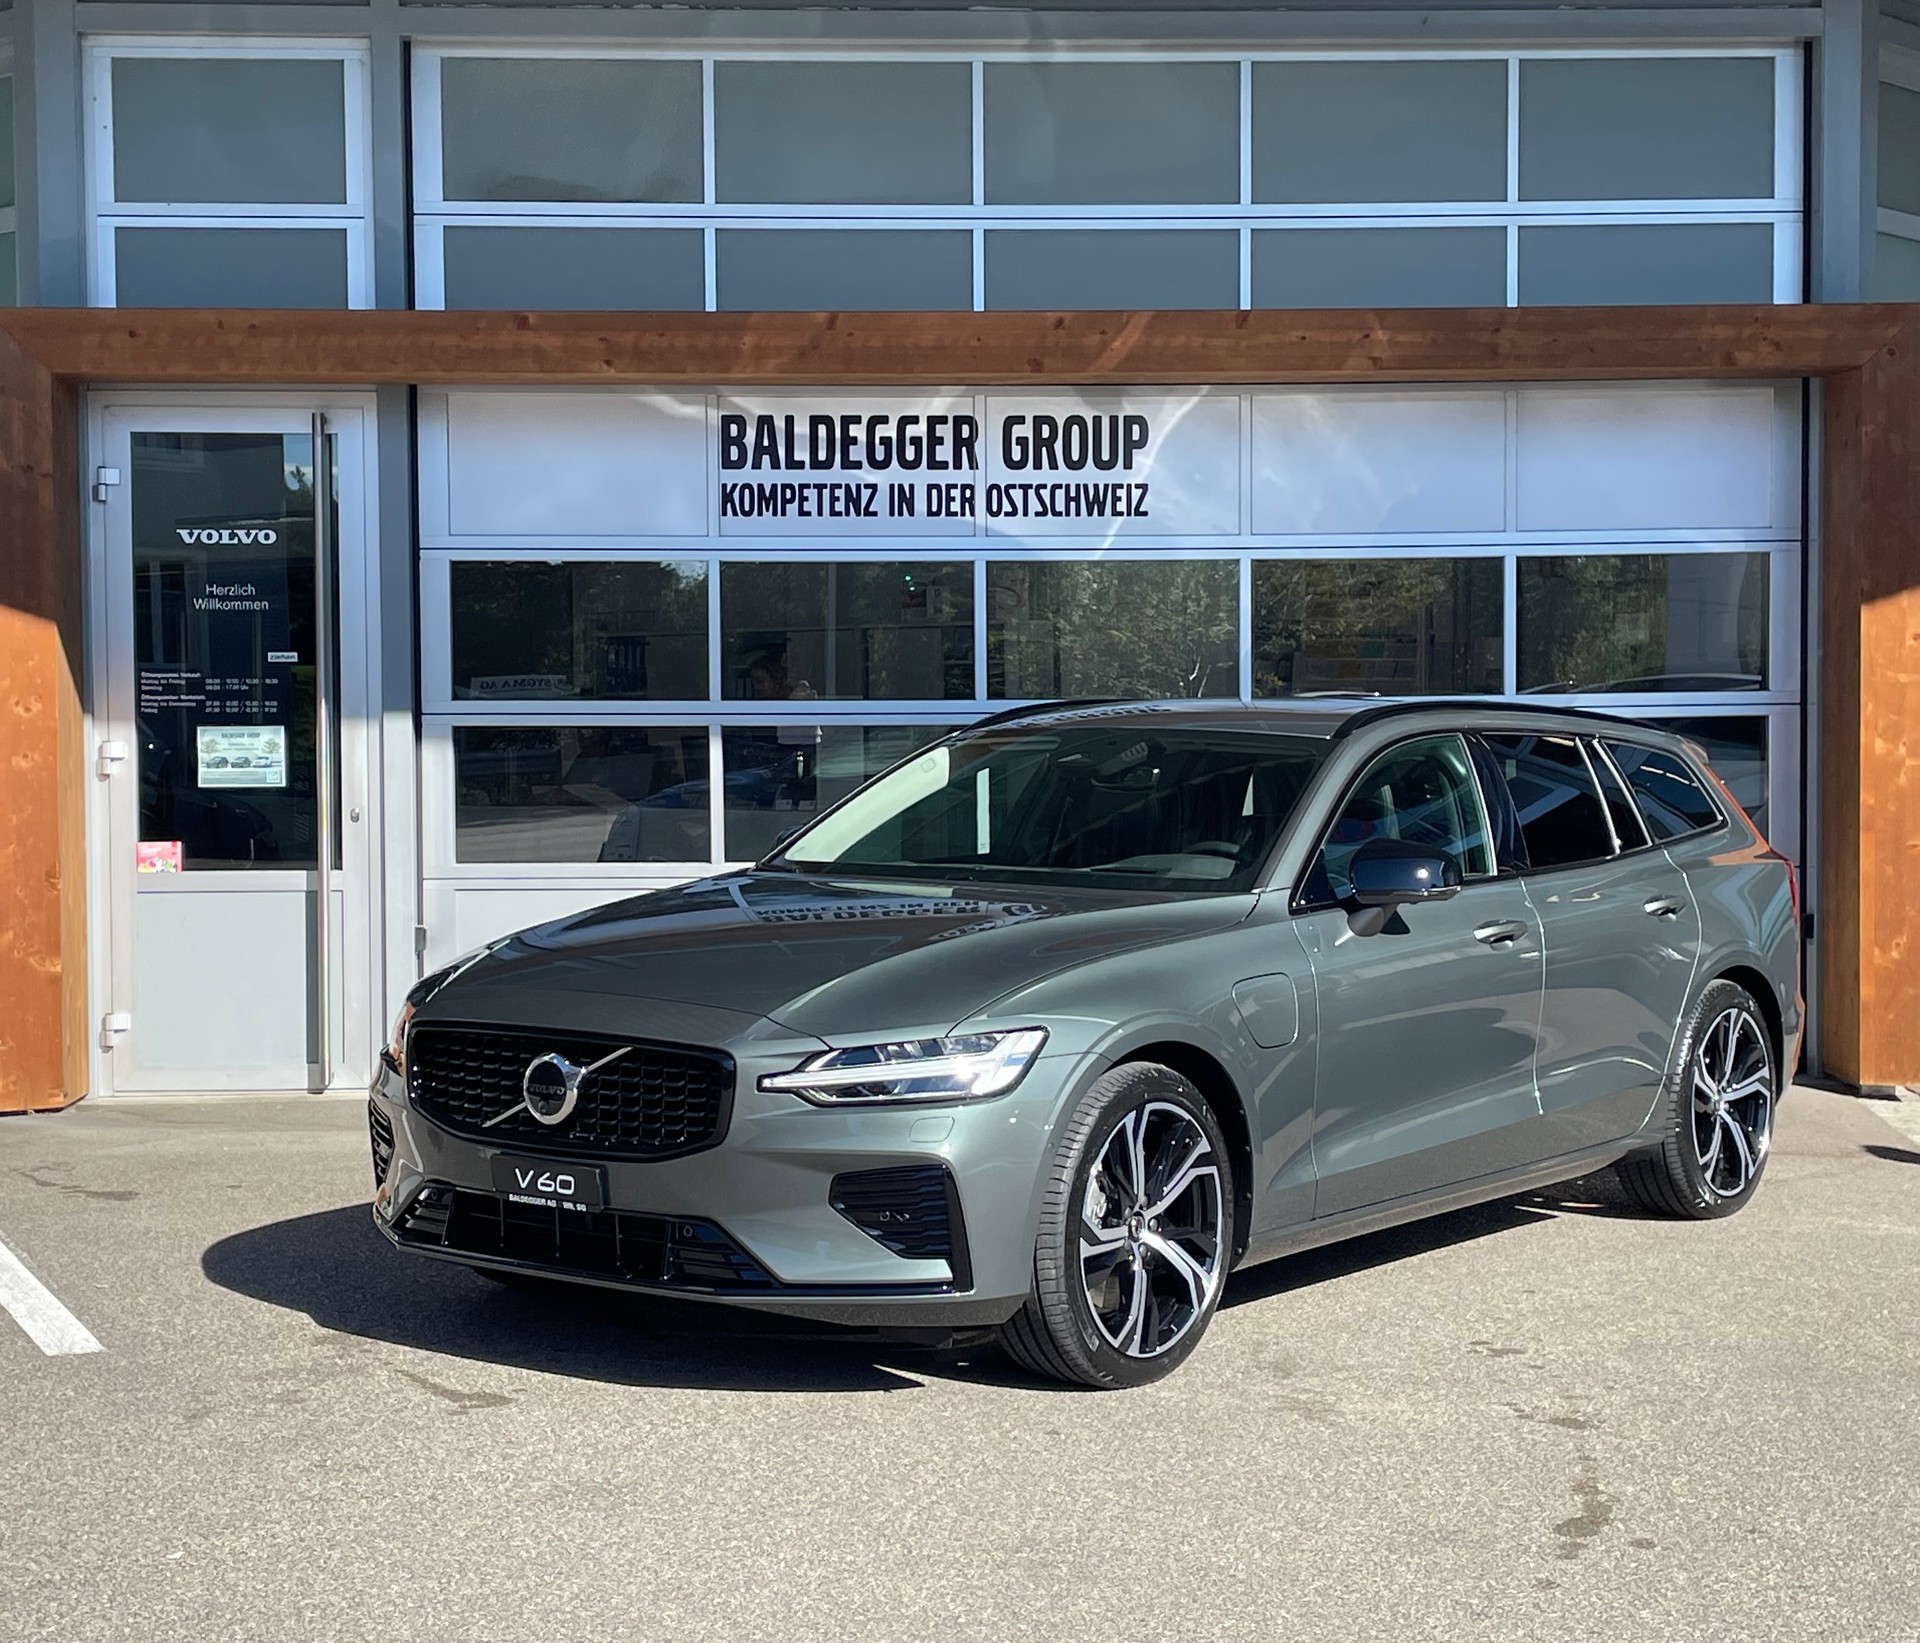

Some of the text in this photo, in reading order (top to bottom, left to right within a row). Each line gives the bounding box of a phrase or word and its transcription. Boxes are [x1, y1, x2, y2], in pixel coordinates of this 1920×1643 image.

[720, 415, 1150, 471] BALDEGGER GROUP
[720, 483, 1149, 518] KOMPETENZ IN DER OSTSCHWEIZ
[176, 528, 277, 545] VOLVO
[205, 583, 256, 596] Herzlich
[193, 598, 270, 611] Willkommen
[529, 1084, 565, 1096] VOLVO
